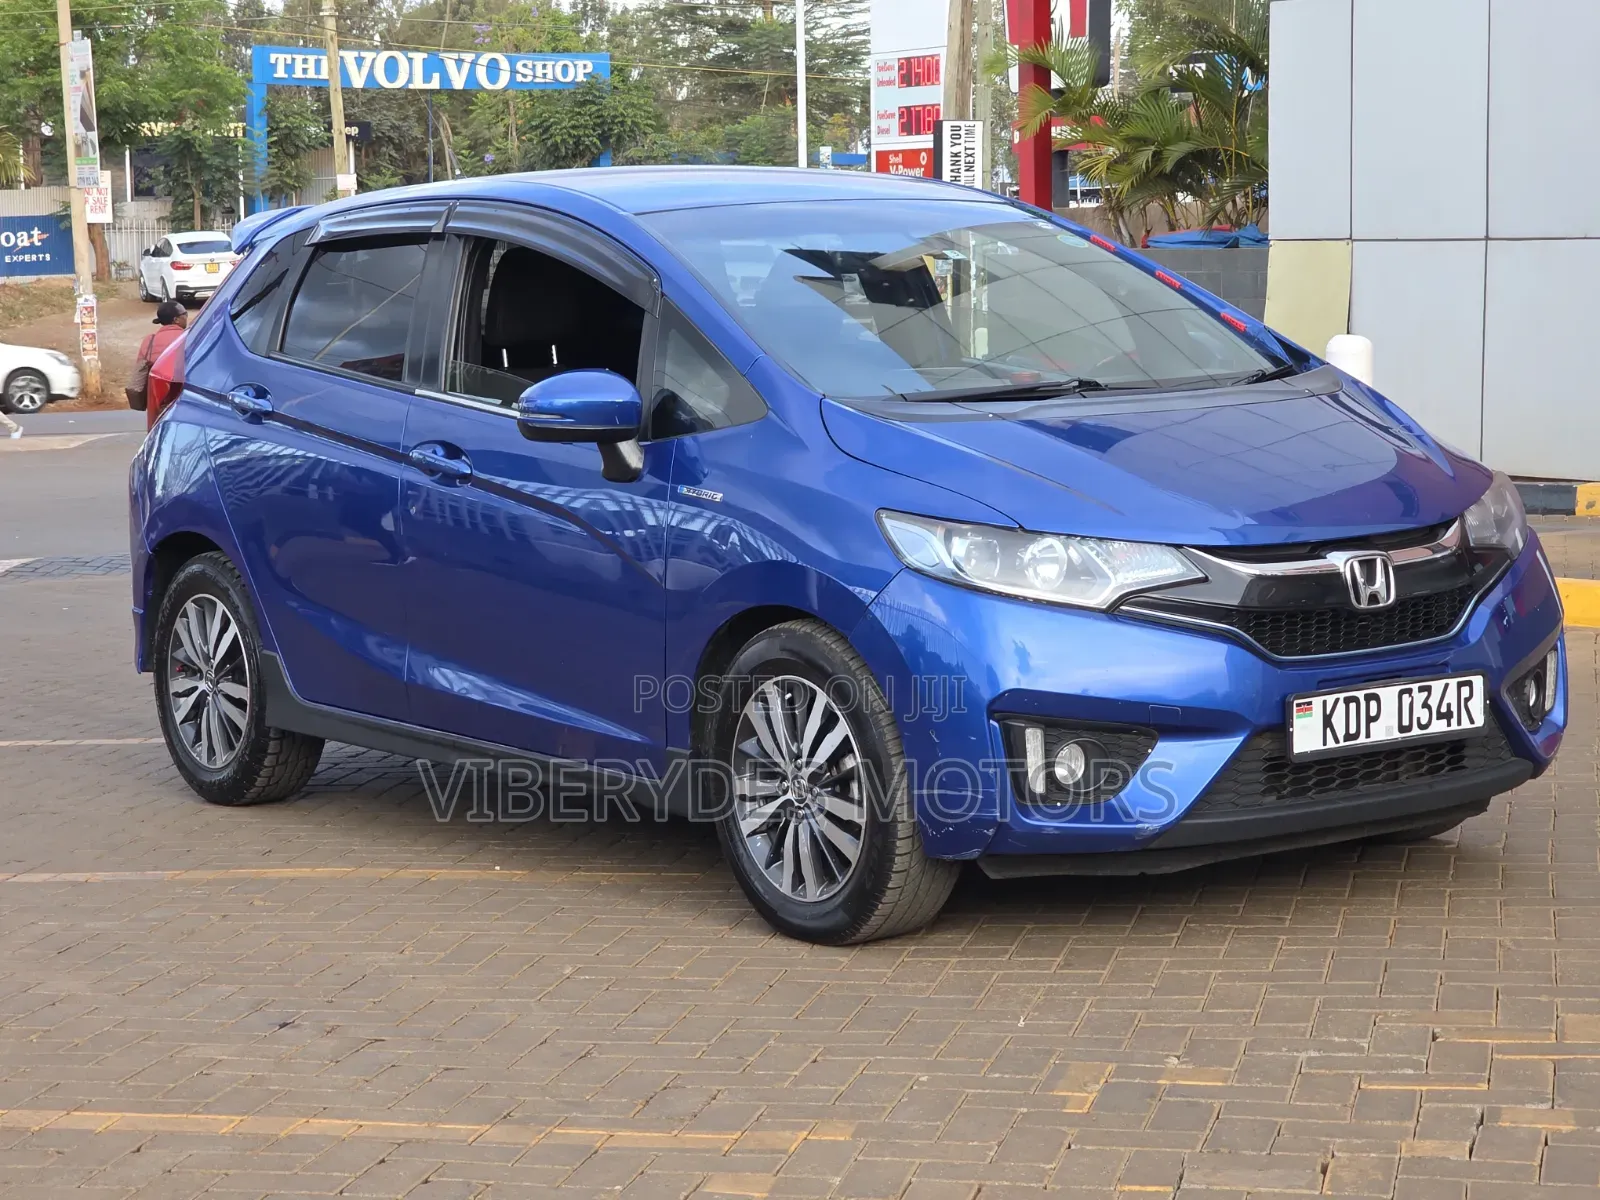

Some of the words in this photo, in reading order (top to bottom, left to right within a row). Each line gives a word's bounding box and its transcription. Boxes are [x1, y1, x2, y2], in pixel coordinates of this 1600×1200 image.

[339, 50, 510, 90] VOLVO
[515, 59, 594, 84] SHOP
[876, 61, 896, 73] FuelSave
[876, 75, 896, 88] Unleaded
[876, 110, 896, 121] FuelSave
[876, 124, 891, 136] Diesel
[964, 123, 976, 144] TIME
[950, 125, 962, 148] YOU
[888, 153, 903, 164] Shell
[964, 146, 976, 172] NEXT
[92, 197, 108, 206] SALE
[90, 205, 107, 214] RENT
[5, 253, 51, 263] EXPERTS
[1322, 692, 1382, 747] KDP
[1397, 679, 1475, 734] 034R
